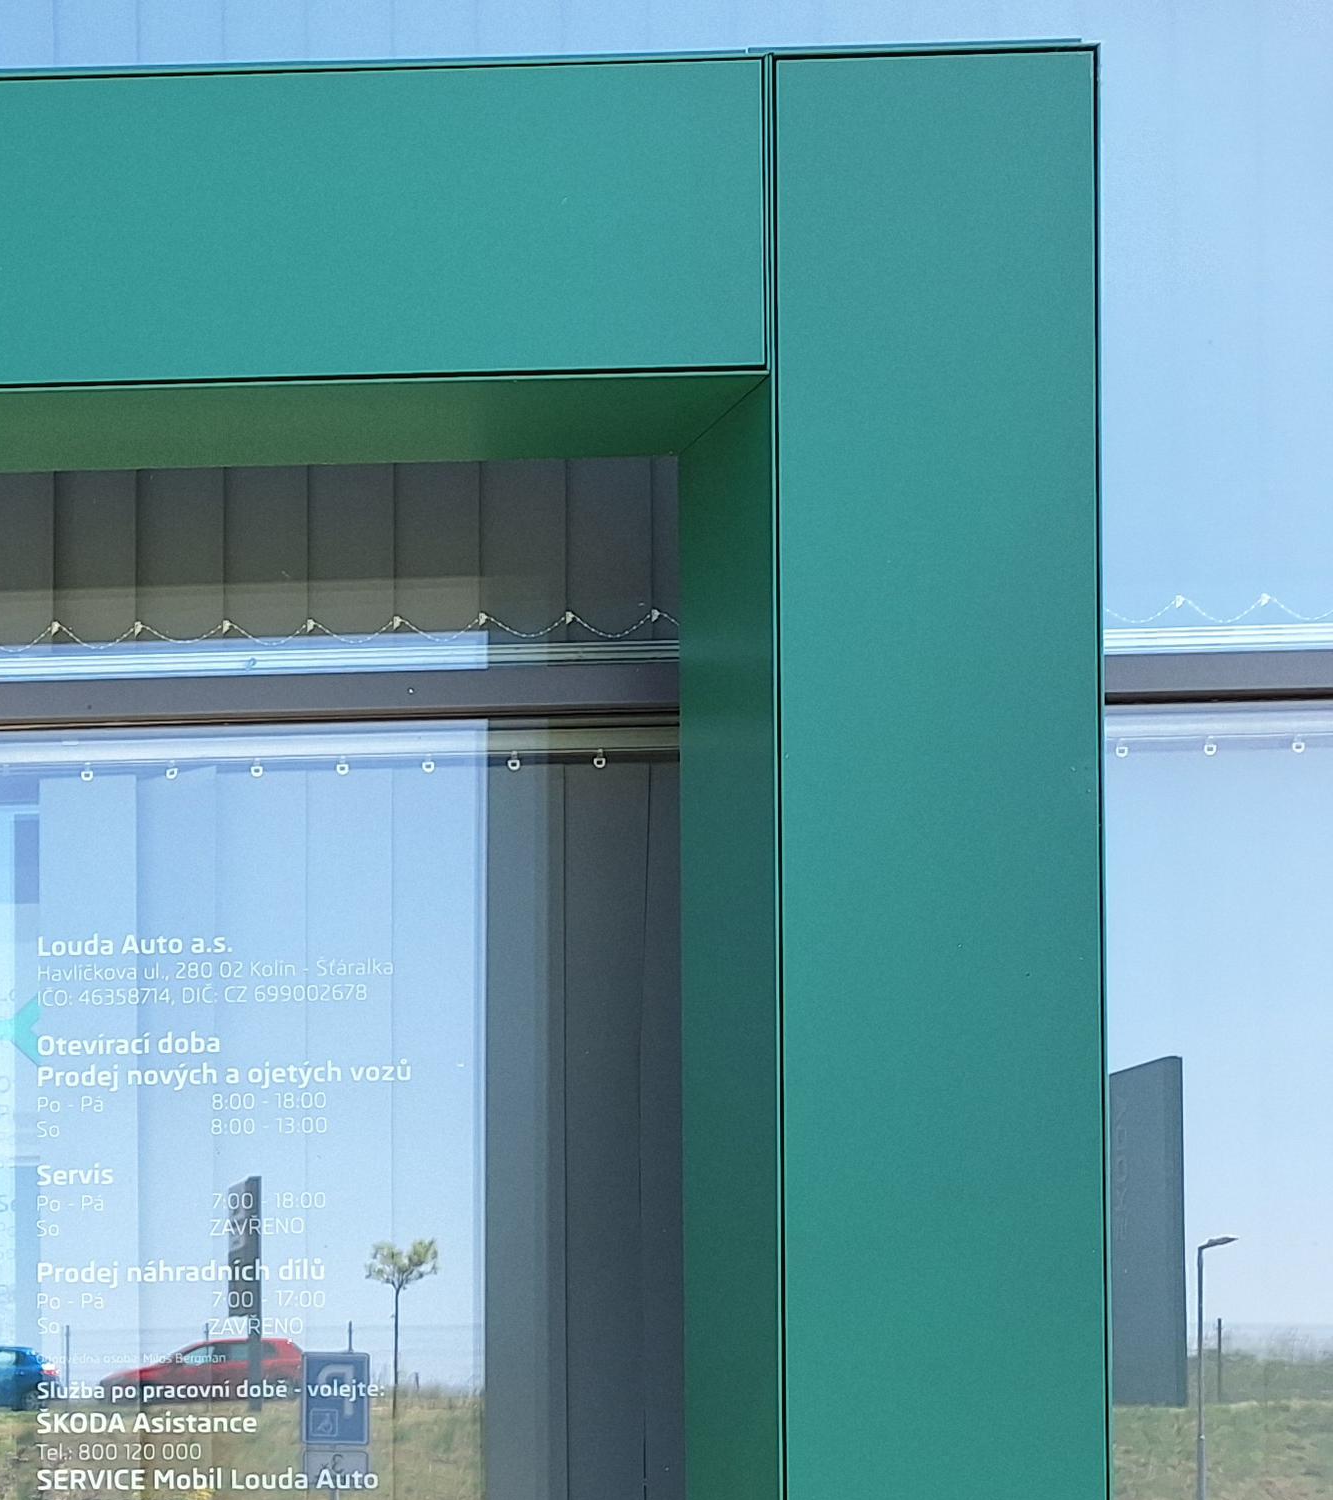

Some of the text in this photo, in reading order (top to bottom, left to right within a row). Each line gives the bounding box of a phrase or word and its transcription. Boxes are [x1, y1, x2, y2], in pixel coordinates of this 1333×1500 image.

[37, 933, 233, 956] Louda Auto a.s.
[37, 962, 137, 981] Havlíčkova
[175, 961, 213, 979] 280
[220, 961, 244, 978] 02
[250, 960, 296, 977] Kolín
[37, 983, 367, 1007] IČO: 46358714, DIČ: CZ 699002678
[37, 1031, 221, 1056] Otevírací doba
[37, 1058, 412, 1092] Prodej nových a ojetých vozů
[37, 1096, 61, 1113] Po
[81, 1095, 104, 1113] Pá
[211, 1092, 255, 1110] 8:00
[274, 1091, 327, 1109] 18:00
[36, 1121, 60, 1137] So
[210, 1117, 255, 1135] 8:00
[276, 1116, 328, 1134] 13:00
[36, 1162, 114, 1186] Servis
[37, 1195, 61, 1212] Po
[81, 1194, 104, 1211] Pá
[211, 1192, 254, 1210] 7:00
[275, 1191, 326, 1209] 18:00
[36, 1214, 305, 1237] So ZAVŘENO
[37, 1257, 326, 1289] Prodej náhradních dílů
[37, 1293, 61, 1310] Po
[81, 1292, 105, 1310] Pá
[211, 1290, 254, 1308] 7:00
[276, 1290, 326, 1308] 17:00
[36, 1314, 304, 1336] So ZAVŘENO
[37, 1380, 106, 1400] Služba
[112, 1386, 137, 1403] po
[143, 1380, 230, 1403] pracovní
[236, 1379, 288, 1398] době
[307, 1378, 386, 1402] volejte:
[36, 1408, 258, 1435] ŠKODA Asistance
[36, 1443, 202, 1461] Tel.: 800 120 000
[36, 1467, 379, 1491] SERVICE Mobil Louda Auto
